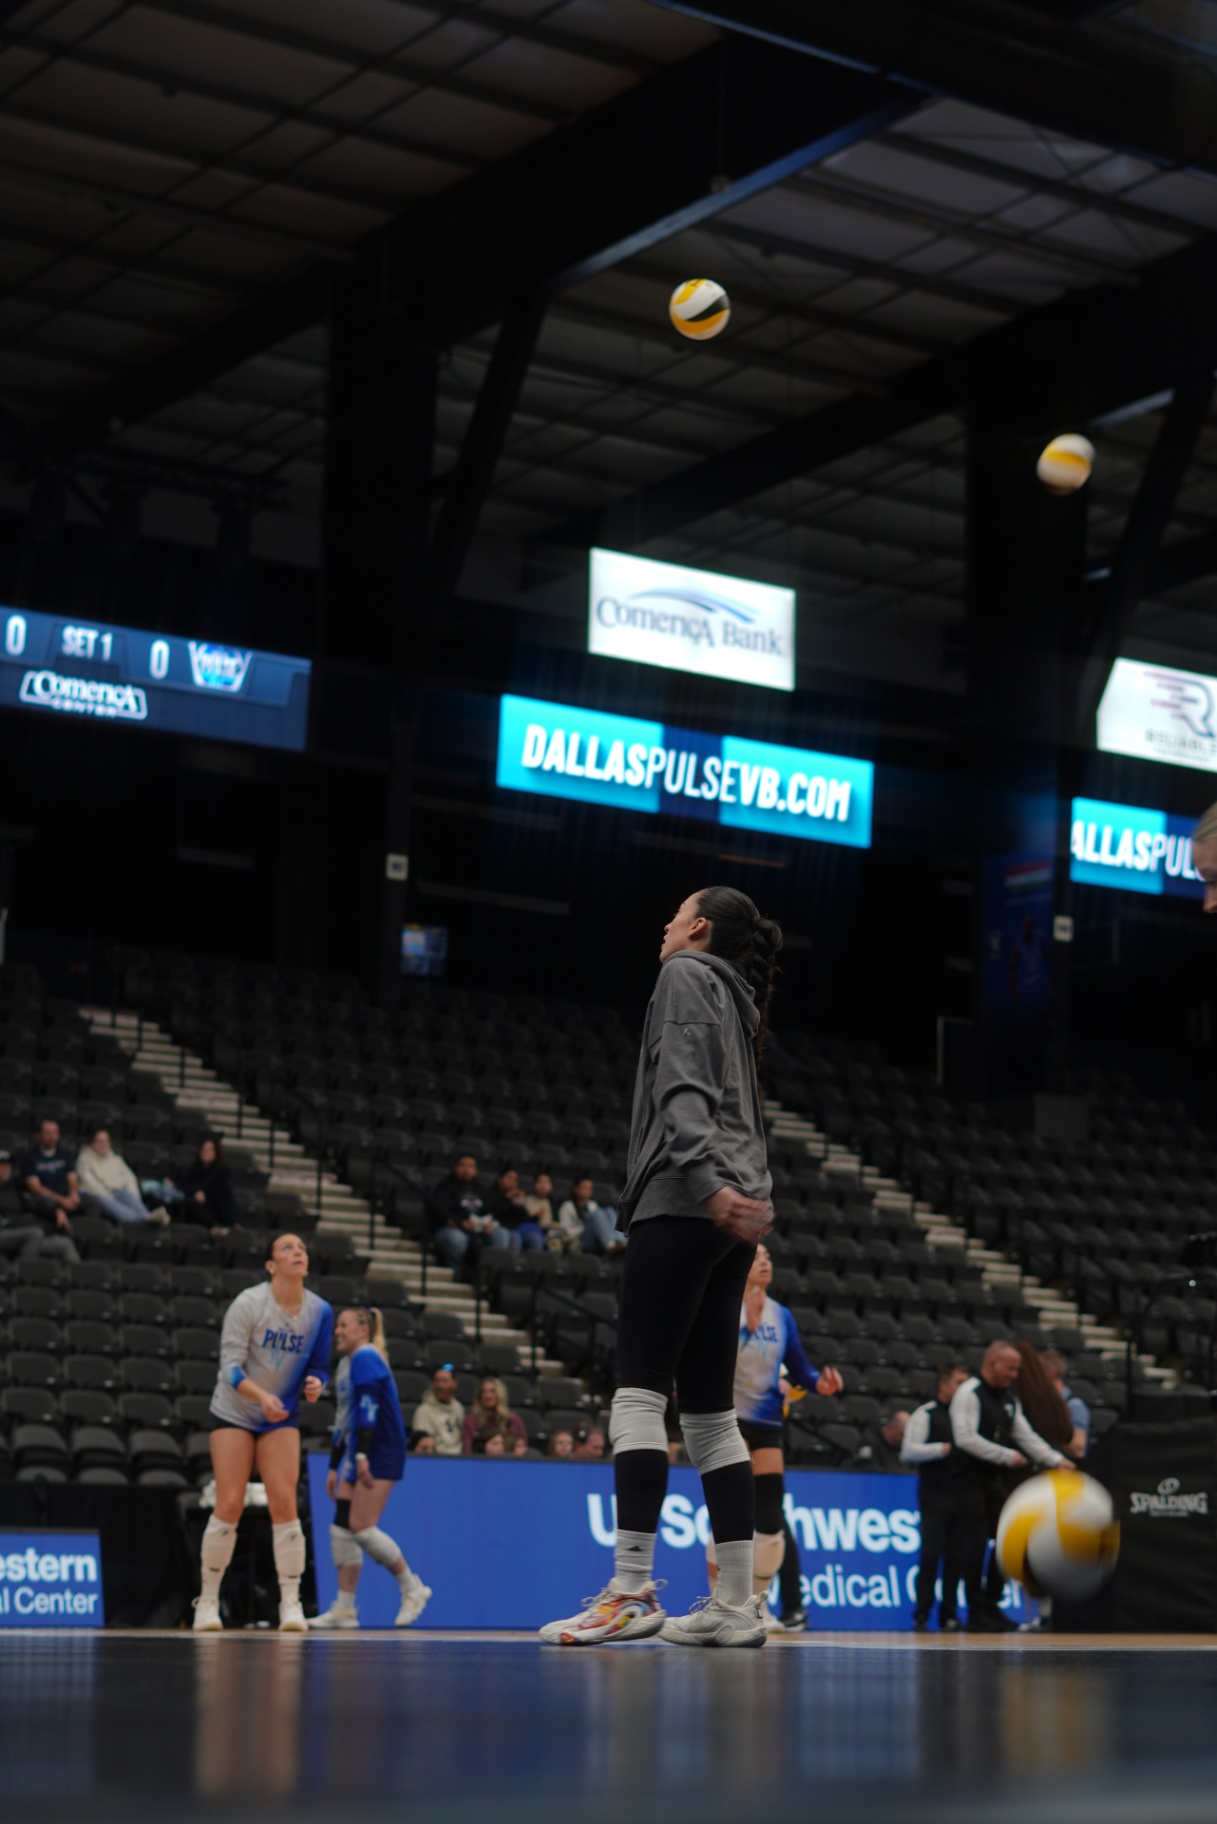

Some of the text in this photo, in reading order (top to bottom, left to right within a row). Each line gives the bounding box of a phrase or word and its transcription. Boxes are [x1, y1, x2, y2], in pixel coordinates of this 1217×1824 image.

[6, 614, 27, 656] 0
[62, 624, 112, 662] SET 1
[722, 619, 783, 656] Bank
[150, 639, 170, 680] 0
[521, 723, 852, 823] DALLASPULSEVB.COM
[1071, 820, 1207, 882] ALLASPUL
[1130, 1491, 1208, 1514] SPALDING
[0, 1547, 97, 1582] stern
[14, 1586, 98, 1614] Center
